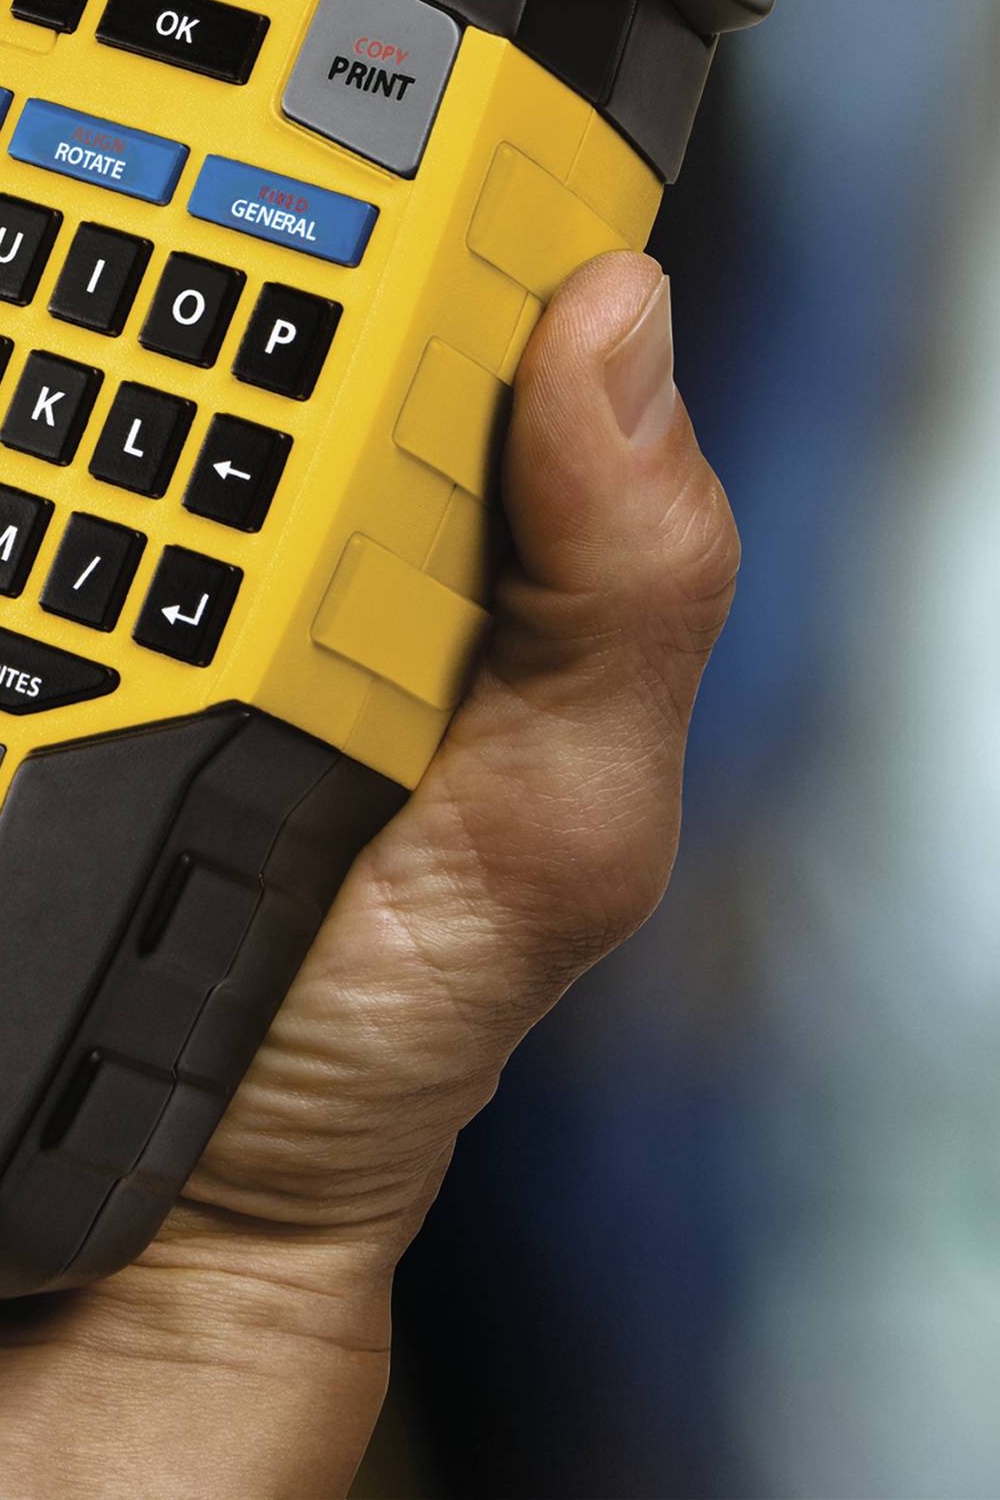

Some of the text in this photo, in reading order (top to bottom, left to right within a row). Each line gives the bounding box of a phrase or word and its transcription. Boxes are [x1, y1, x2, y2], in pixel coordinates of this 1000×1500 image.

[156, 10, 200, 44] OK
[354, 37, 409, 66] COPY
[327, 56, 416, 102] PRINT
[71, 127, 125, 155] ALIGN
[54, 143, 126, 180] ROTATE
[259, 186, 308, 213] FIXED
[231, 199, 316, 241] GENERAL
[86, 259, 105, 294] I
[172, 289, 205, 325] O
[264, 319, 297, 355] P
[31, 385, 65, 428] K
[123, 418, 146, 458] L
